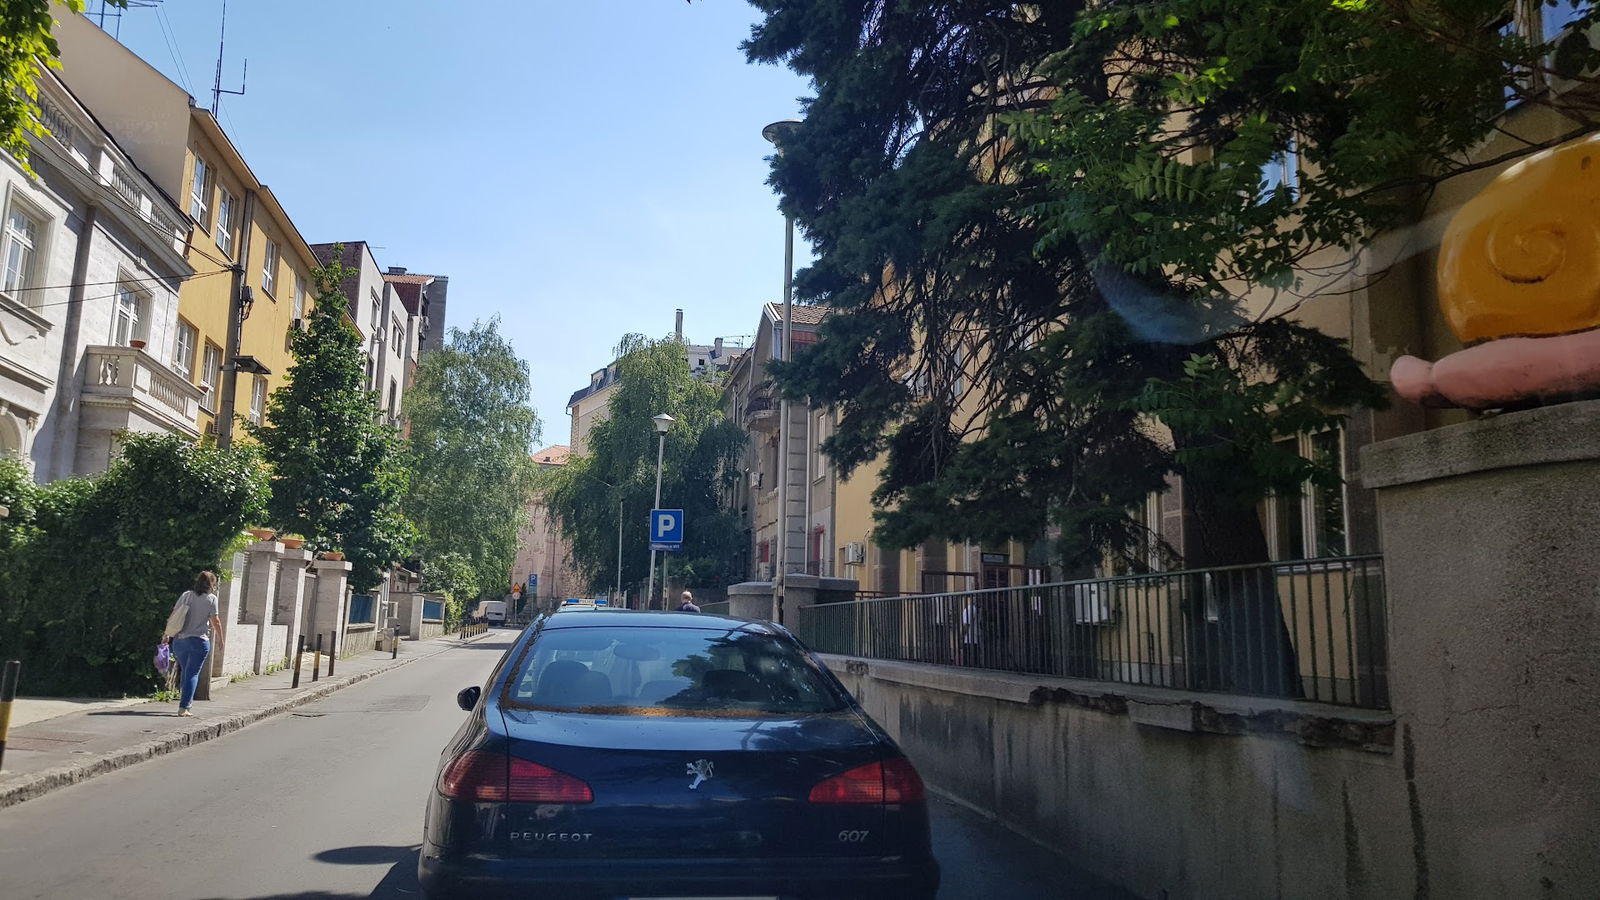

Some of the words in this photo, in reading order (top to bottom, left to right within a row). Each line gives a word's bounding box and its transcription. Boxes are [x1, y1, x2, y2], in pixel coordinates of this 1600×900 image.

[658, 515, 675, 537] P
[510, 832, 592, 841] PEUGEOT
[838, 830, 869, 842] 607
